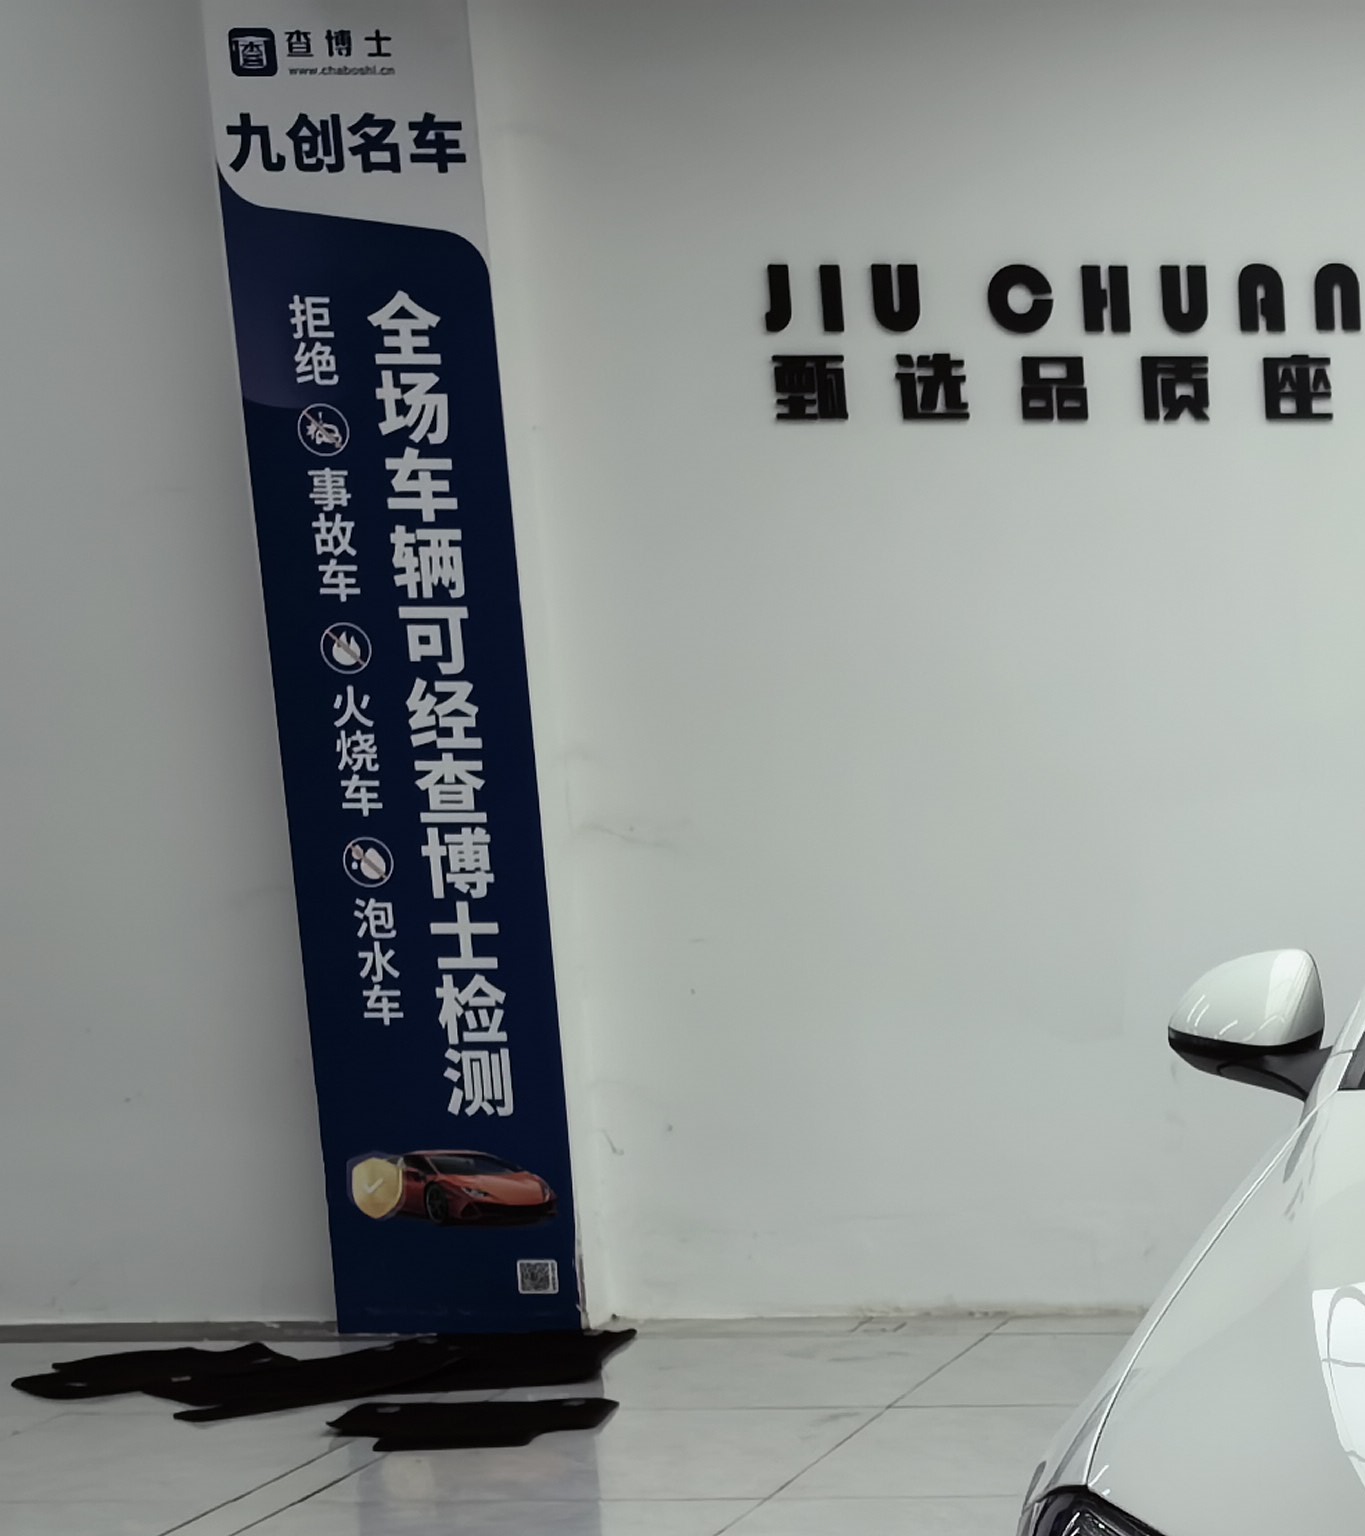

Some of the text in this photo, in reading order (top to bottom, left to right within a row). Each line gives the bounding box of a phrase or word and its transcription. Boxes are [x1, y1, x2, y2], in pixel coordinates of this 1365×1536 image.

[285, 29, 392, 57] 查博士
[226, 112, 467, 173] 九创名车
[765, 264, 921, 334] JIU
[289, 295, 404, 1025] 拒绝 事故车 火烧车 泡水车
[367, 290, 514, 1117] 全场车辆可经查博士检测
